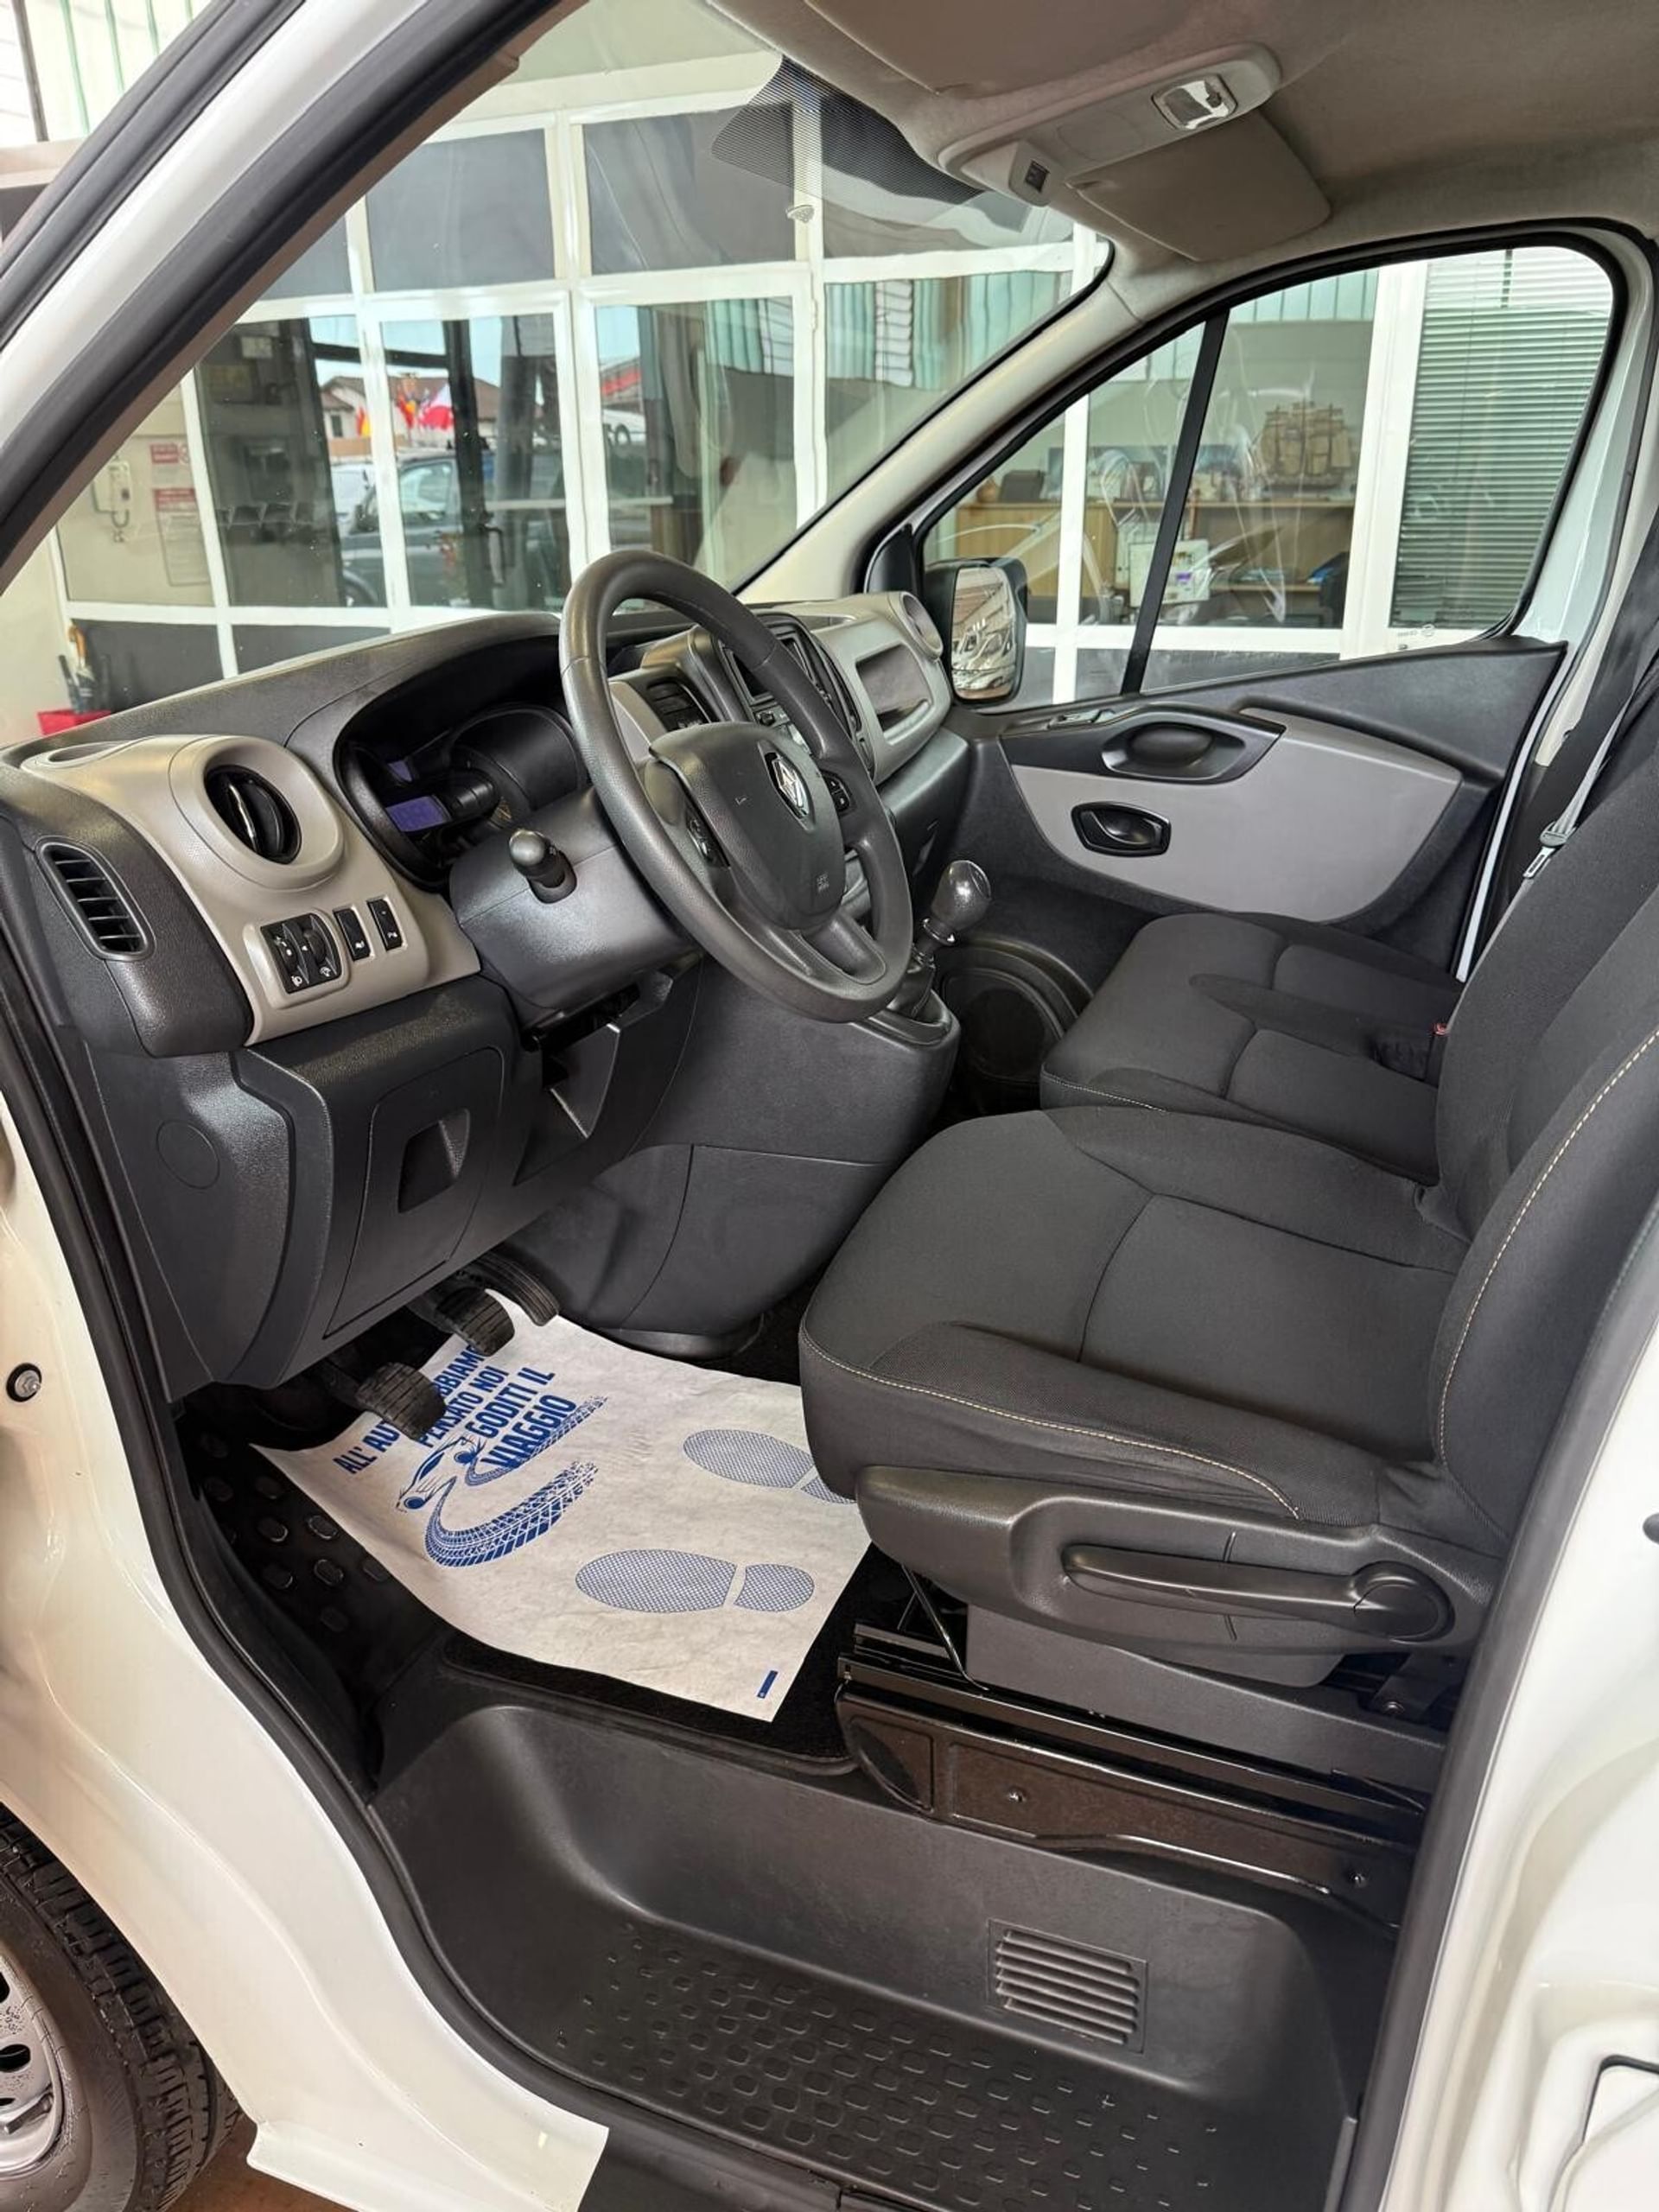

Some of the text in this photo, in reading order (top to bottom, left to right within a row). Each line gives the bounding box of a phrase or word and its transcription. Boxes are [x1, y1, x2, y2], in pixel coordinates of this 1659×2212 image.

[464, 1367, 556, 1439] GODITI IL
[468, 1365, 510, 1393] NOI
[480, 1395, 576, 1469] VIAGGIO
[332, 1446, 378, 1474] ALL'
